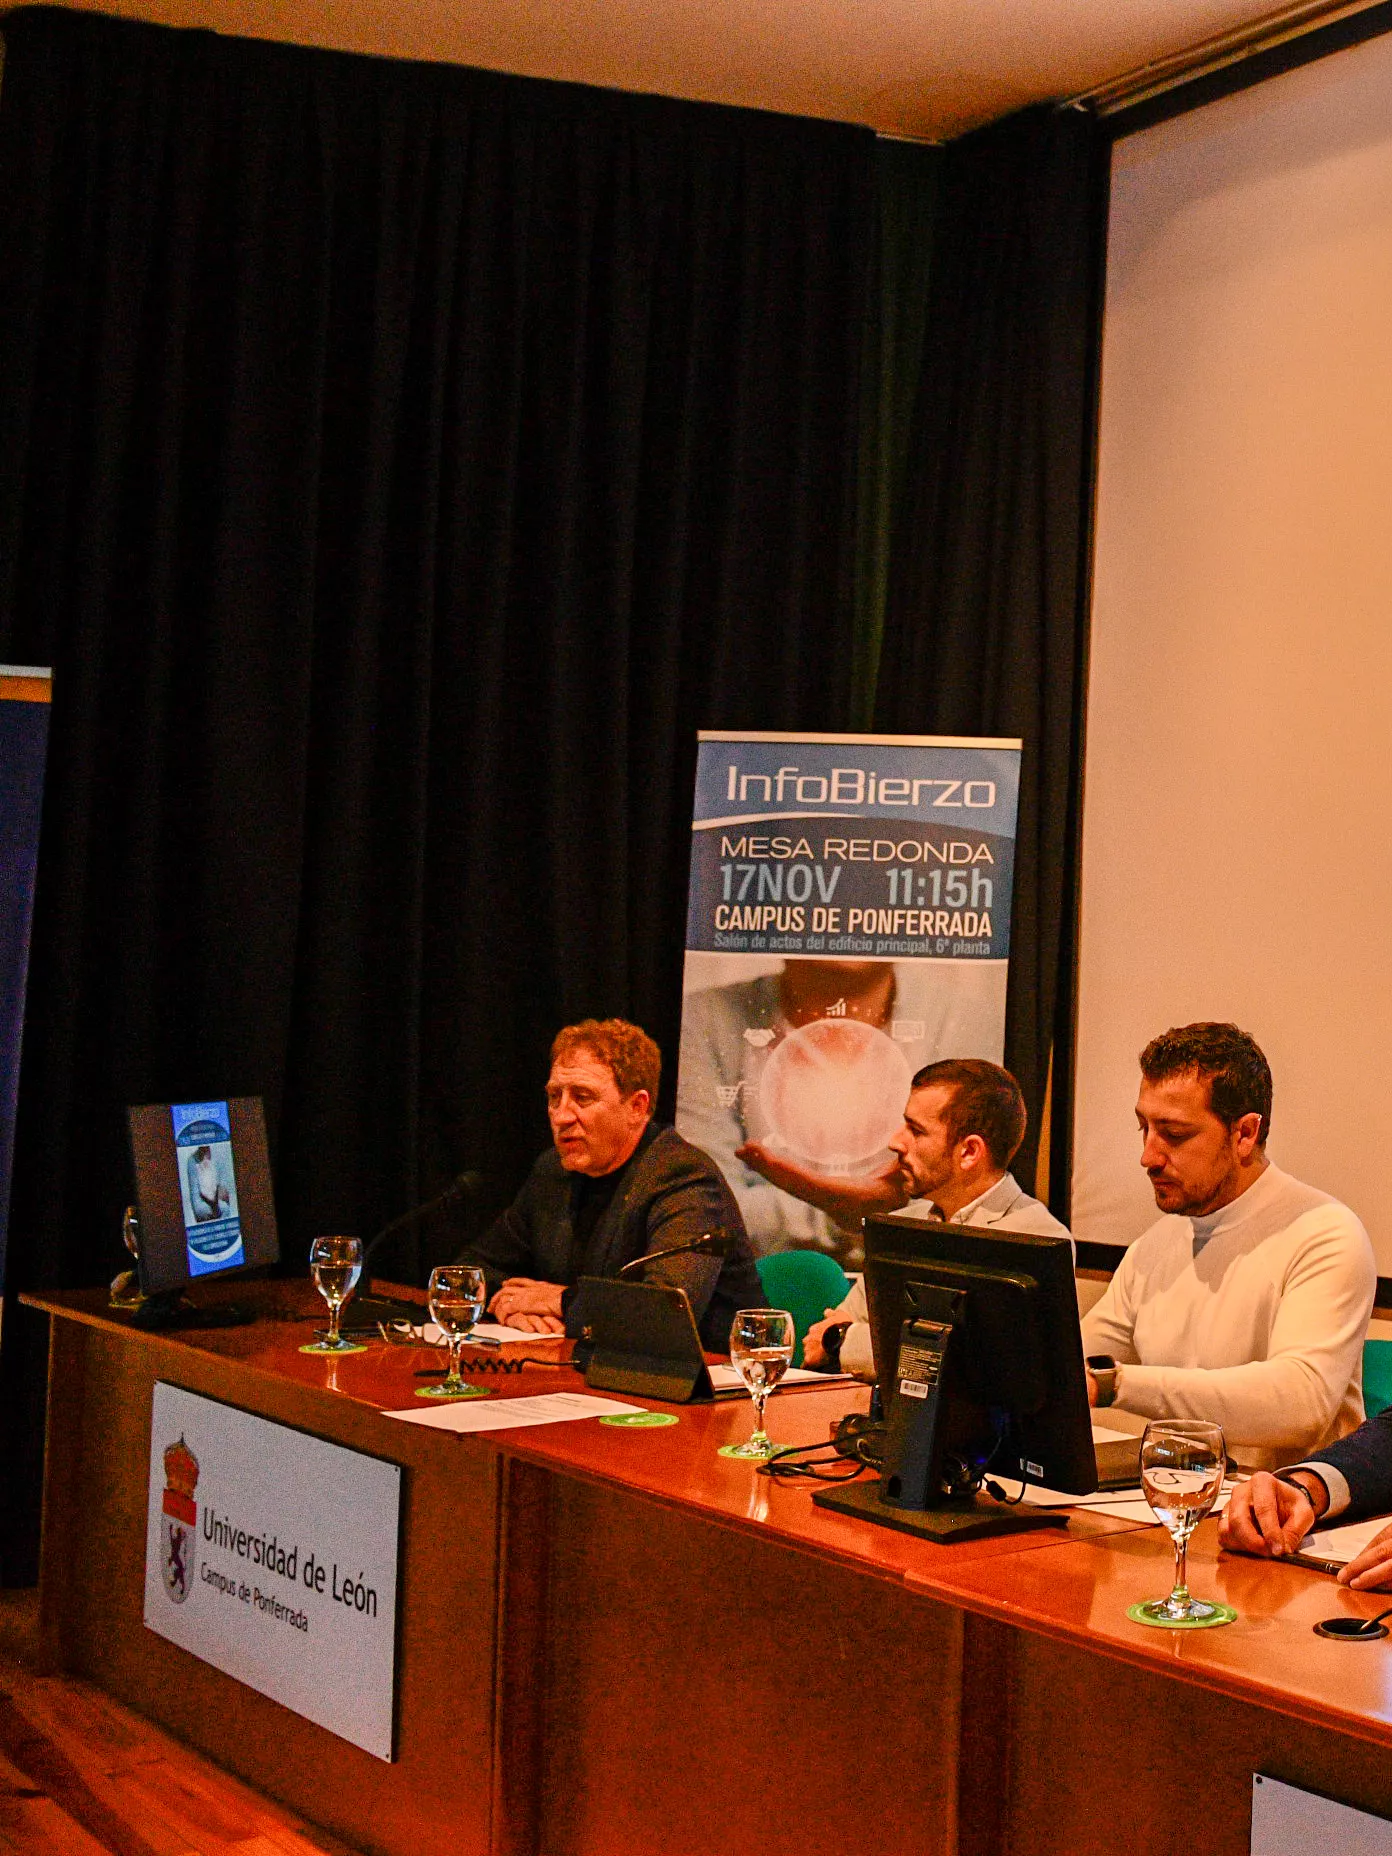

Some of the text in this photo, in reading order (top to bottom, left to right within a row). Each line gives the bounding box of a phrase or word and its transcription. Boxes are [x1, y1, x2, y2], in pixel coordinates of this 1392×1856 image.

[727, 765, 997, 808] InfoBierzo
[721, 836, 995, 865] MESA REDONDA
[720, 863, 993, 908] 17NOV 11:15h
[714, 905, 993, 938] CAMPUS DE PONFERRADA
[751, 934, 766, 949] de
[769, 936, 803, 950] actos
[806, 936, 825, 950] del
[828, 936, 873, 952] edificio
[952, 941, 990, 957] planta
[203, 1507, 378, 1618] Universidad de León
[200, 1562, 308, 1632] Campus de Ponferrada
